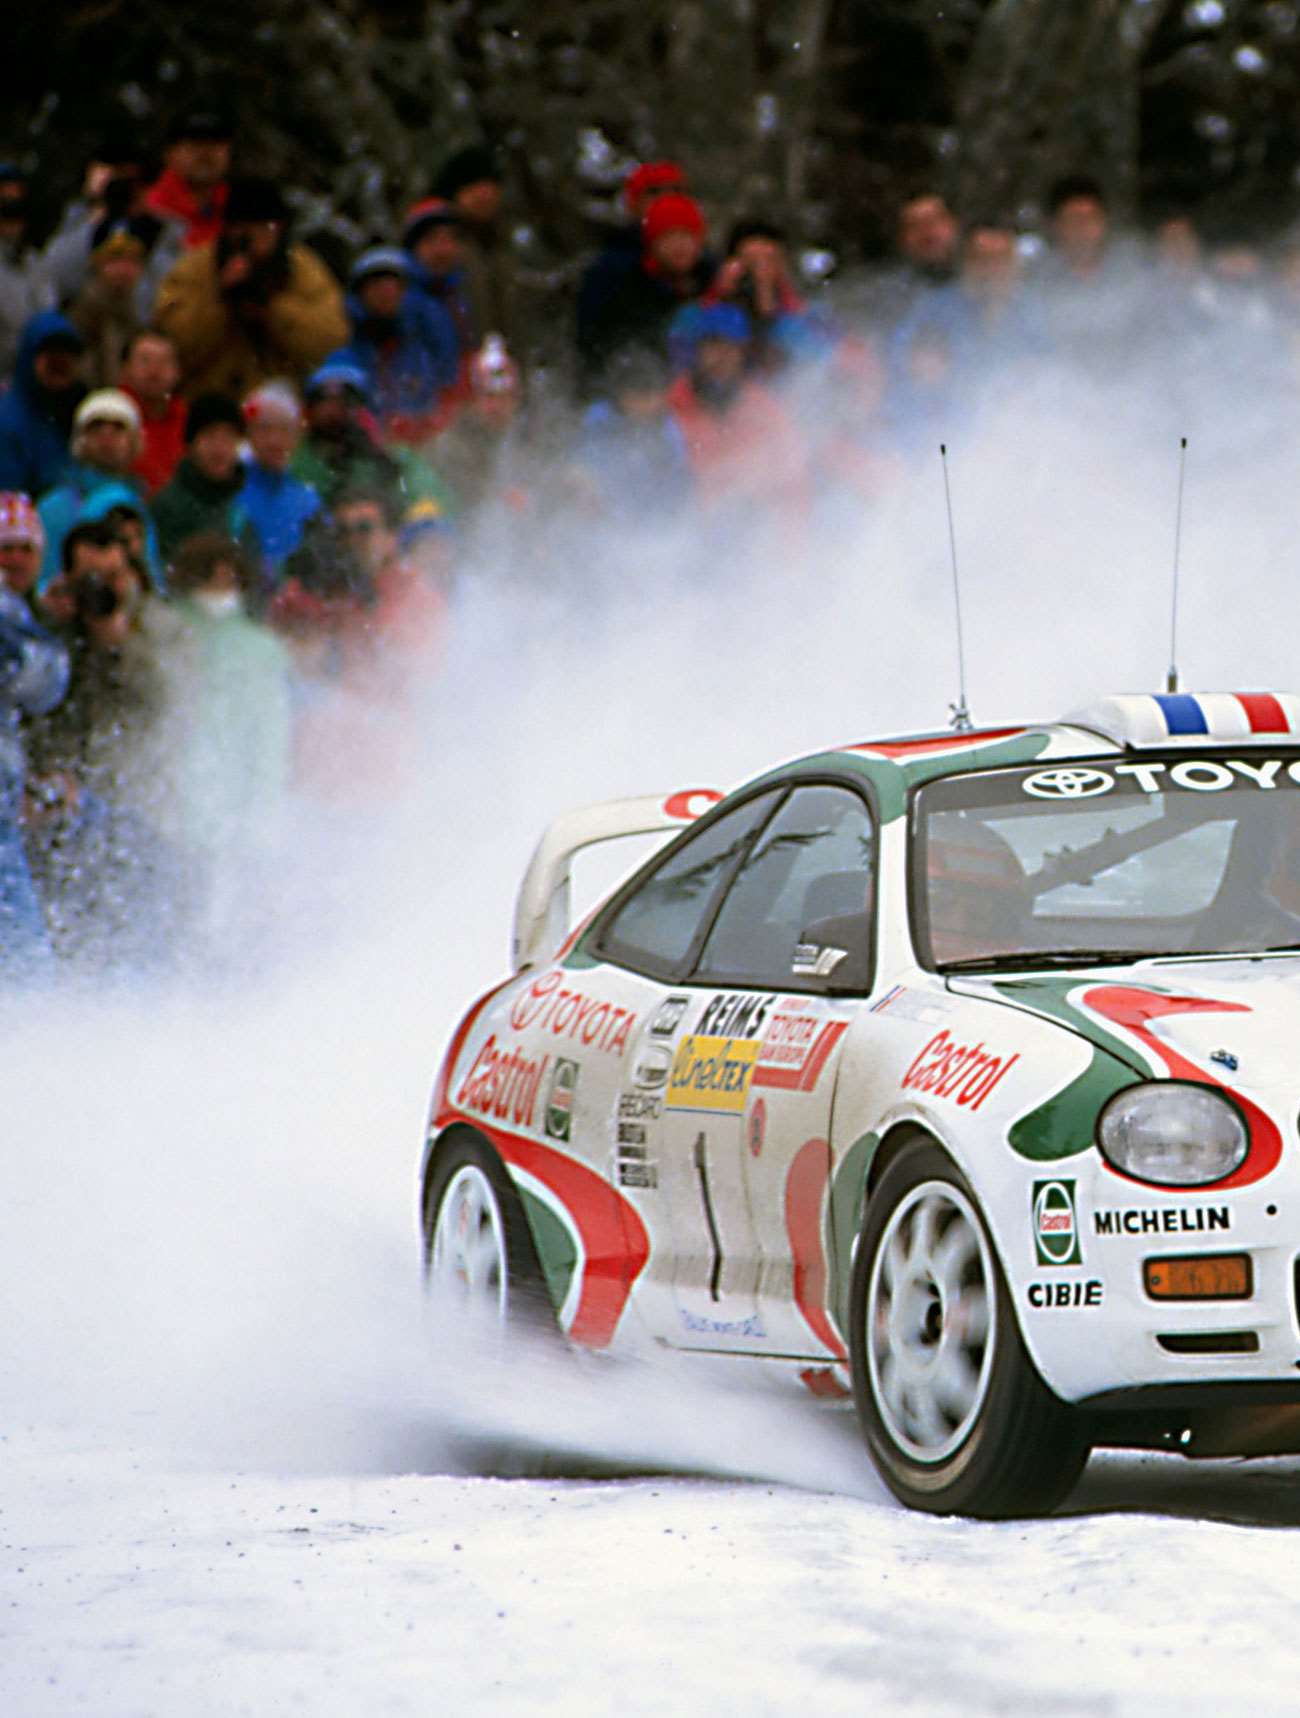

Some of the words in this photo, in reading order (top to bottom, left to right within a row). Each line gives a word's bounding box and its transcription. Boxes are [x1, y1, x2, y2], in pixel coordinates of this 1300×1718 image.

[540, 988, 638, 1058] TOYOTA
[695, 993, 778, 1039] REIMS
[901, 1028, 1021, 1112] Castrol
[1093, 1206, 1231, 1235] MICHELIN
